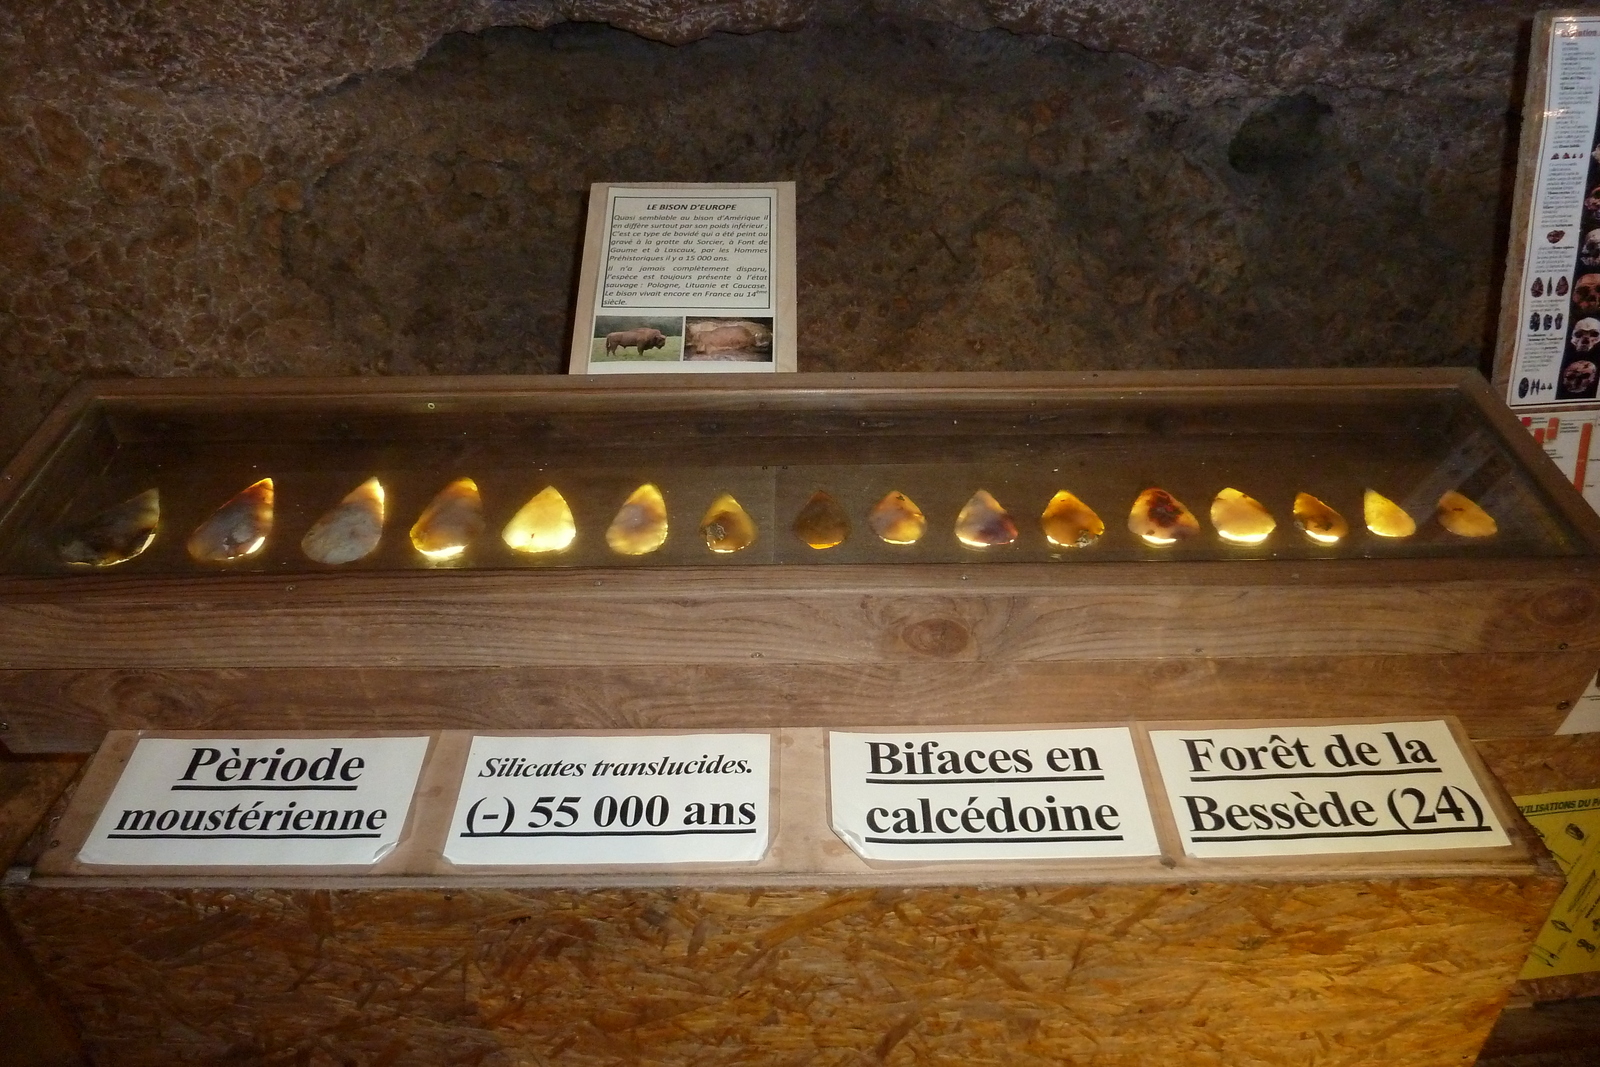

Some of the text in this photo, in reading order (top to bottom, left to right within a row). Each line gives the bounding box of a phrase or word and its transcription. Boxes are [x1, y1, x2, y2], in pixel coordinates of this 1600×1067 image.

[177, 748, 365, 781] Pèriode
[478, 754, 752, 778] Silicates translucides.
[865, 741, 1103, 775] Bifaces en
[1179, 731, 1437, 772] Forêt de la
[113, 801, 387, 831] moustérienne
[467, 795, 756, 834] (-) 55 000 ans
[866, 795, 1121, 834] calcédoine
[1180, 785, 1484, 832] Bessède (24)
[1578, 799, 1591, 808] DU
